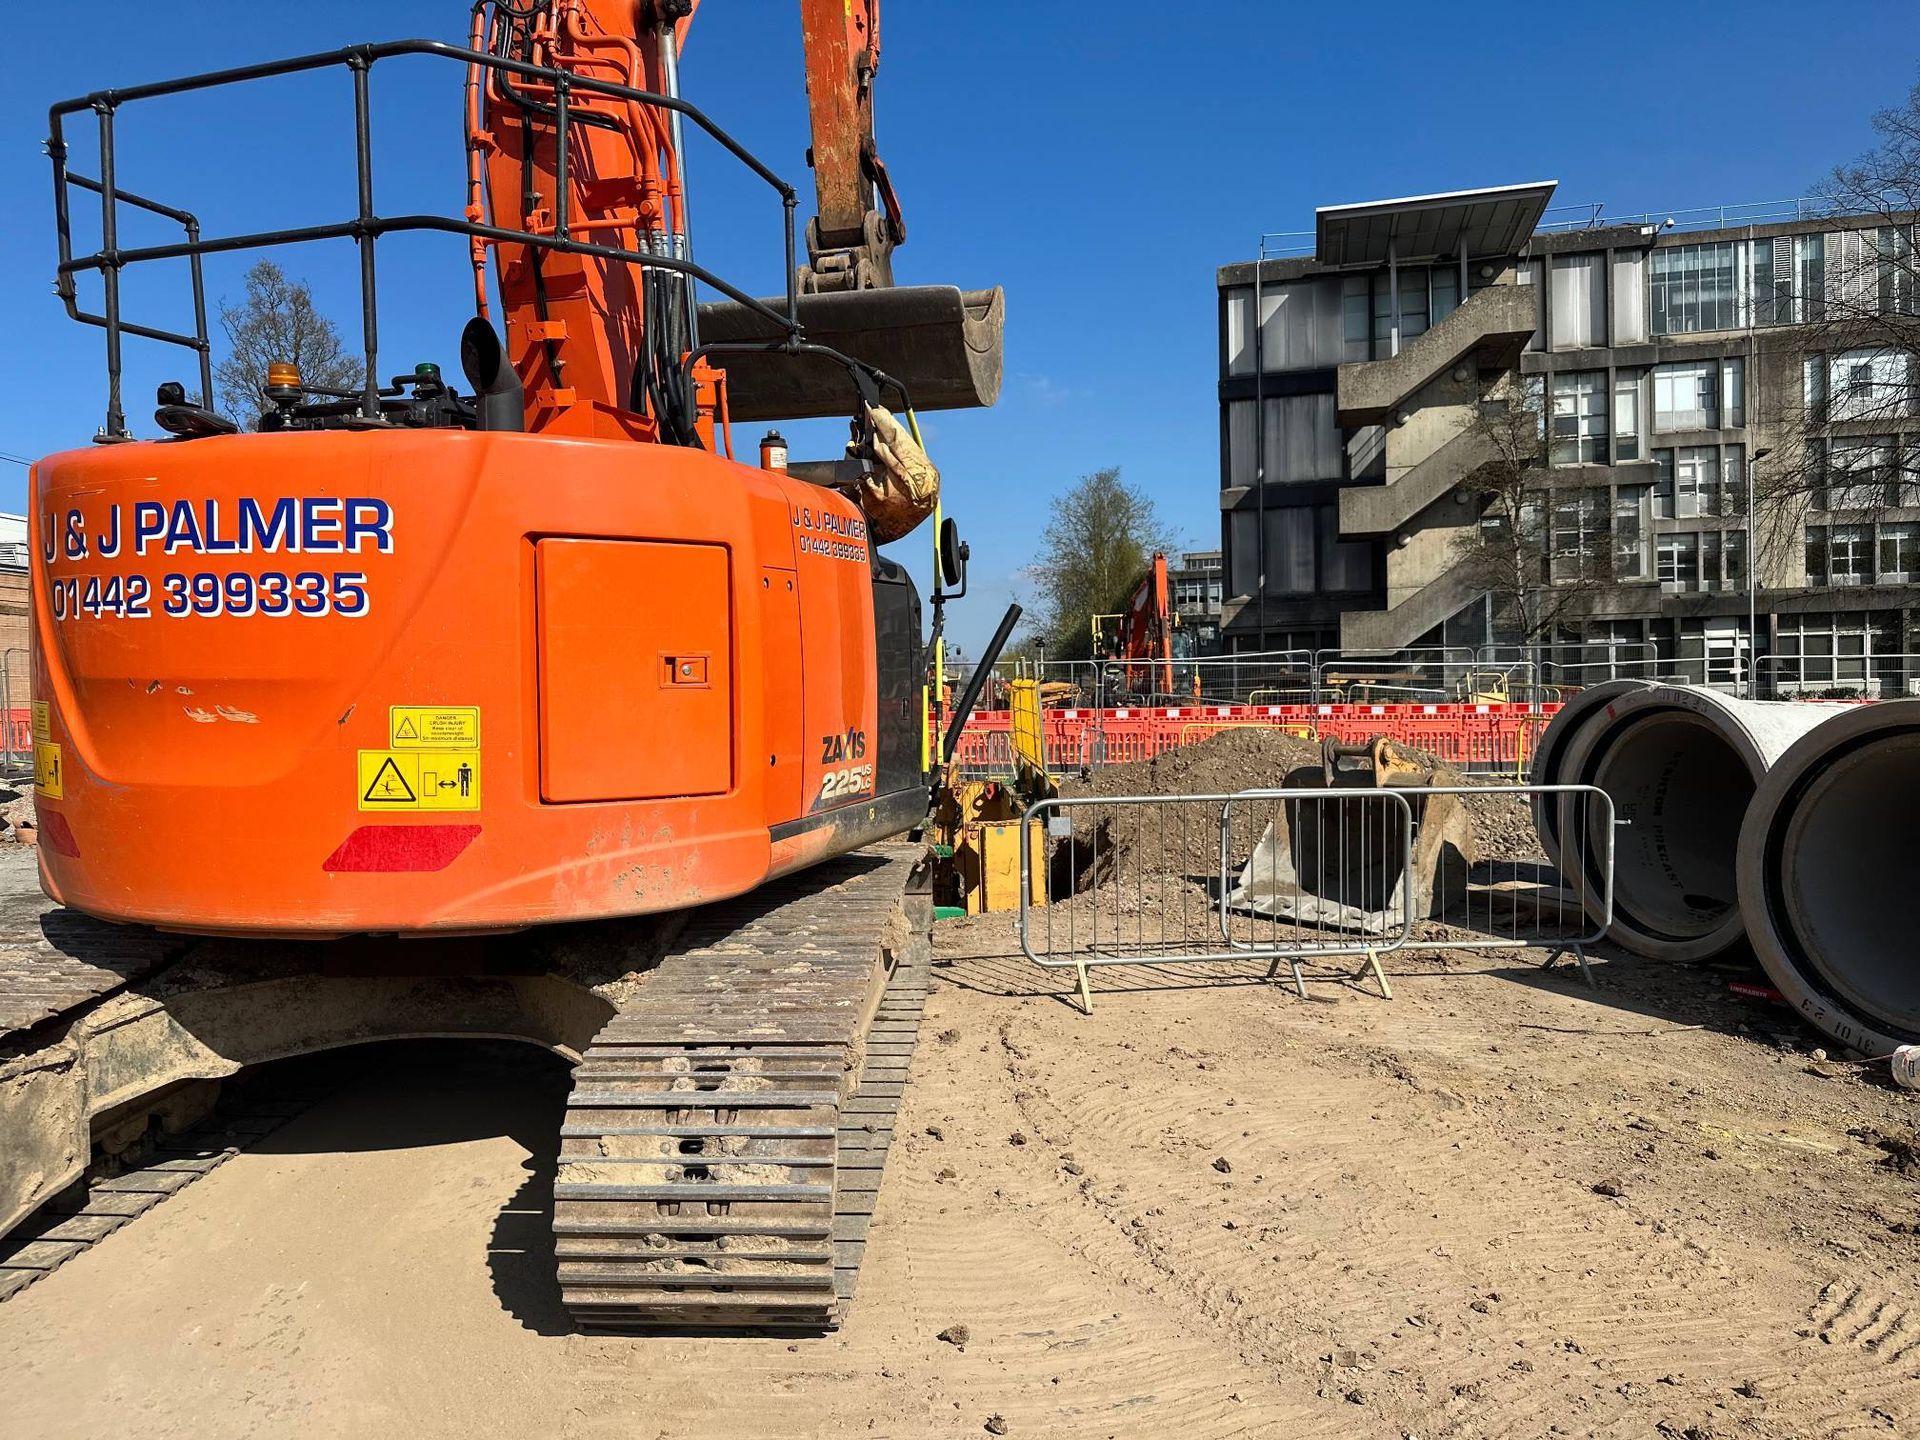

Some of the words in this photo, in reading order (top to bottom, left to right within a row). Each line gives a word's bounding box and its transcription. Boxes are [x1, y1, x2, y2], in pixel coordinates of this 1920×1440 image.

[45, 512, 57, 564] J
[65, 508, 90, 561] &
[97, 503, 122, 559] J
[135, 497, 395, 557] PALMER
[793, 504, 801, 528] J
[804, 507, 814, 530] &
[815, 510, 822, 532] J
[824, 512, 868, 541] PALMER
[800, 535, 832, 558] 01442
[832, 540, 867, 563] 399335
[53, 573, 151, 621] 01442
[162, 571, 370, 619] 399335
[822, 727, 866, 765] ZAXIS
[820, 766, 862, 800] 225
[861, 763, 872, 776] US
[861, 778, 872, 791] LC
[1652, 825, 1684, 890] PRECAST
